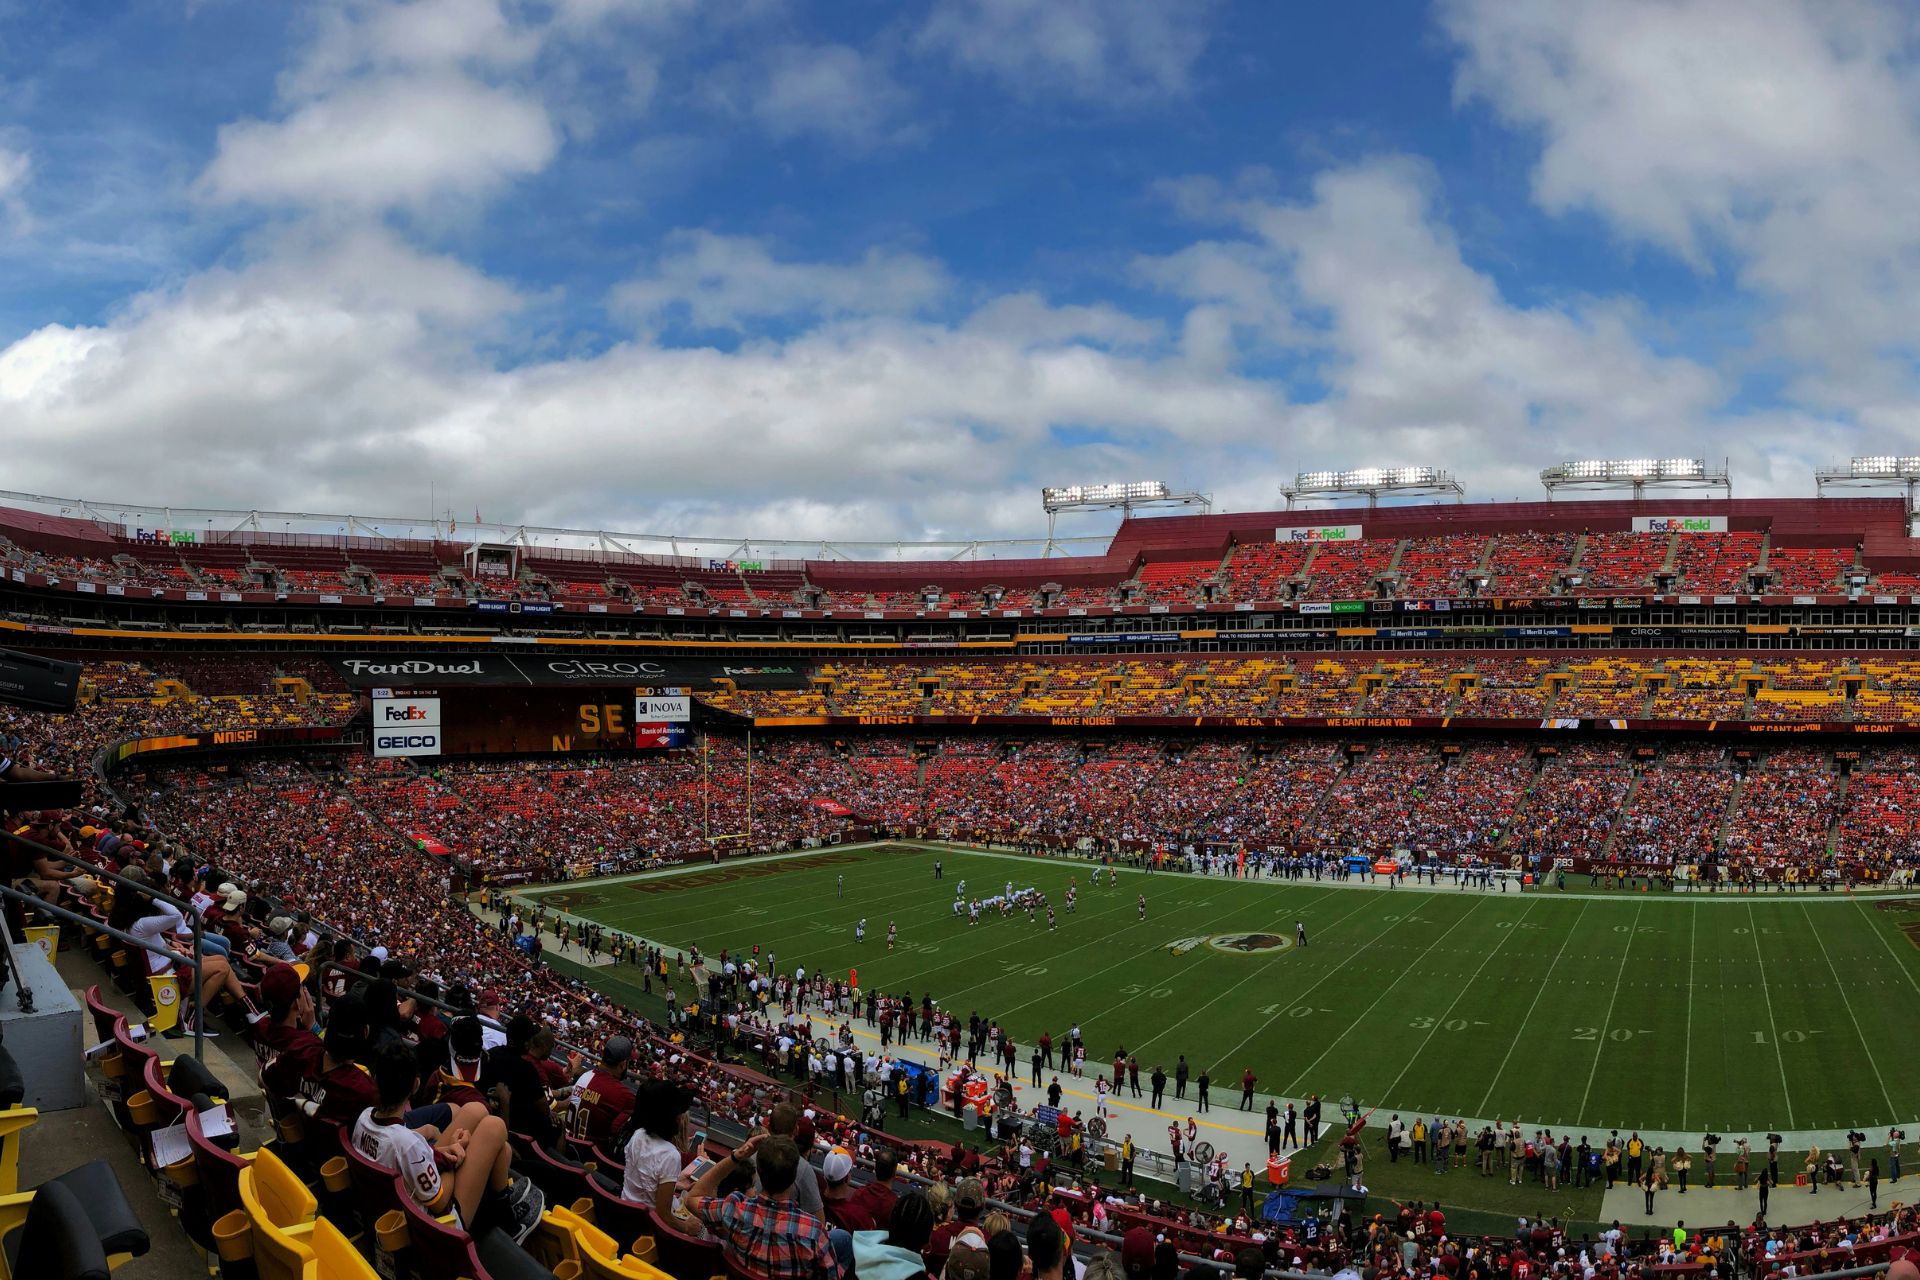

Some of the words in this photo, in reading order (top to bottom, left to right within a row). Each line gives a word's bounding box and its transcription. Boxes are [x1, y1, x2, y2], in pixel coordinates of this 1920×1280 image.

[1649, 518, 1711, 530] FedExField
[1291, 528, 1346, 540] FedExField
[1404, 601, 1431, 610] FedEx
[342, 659, 485, 675] FanDuel
[385, 705, 426, 720] FedEx
[651, 702, 683, 713] INOVA
[1052, 717, 1080, 726] MAKE
[1082, 717, 1115, 726] NOISE!
[1235, 718, 1249, 726] WE
[1326, 718, 1341, 727] WE
[1342, 718, 1366, 727] CANT
[1368, 718, 1392, 727] HEAR
[1393, 718, 1412, 727] YOU
[641, 727, 656, 735] Bank
[656, 727, 663, 735] of
[662, 727, 685, 735] America
[1870, 725, 1894, 733] CANT
[377, 735, 436, 749] GEICO
[1267, 845, 1285, 853] 1972
[1256, 1003, 1313, 1018] 40
[1409, 1016, 1468, 1032] 30
[1571, 1026, 1633, 1042] 20
[1751, 1030, 1806, 1044] 10
[360, 1130, 380, 1161] MOSS
[416, 1163, 438, 1192] 89
[1306, 1227, 1317, 1239] 12
[1415, 1223, 1426, 1236] 60
[1551, 1236, 1563, 1247] 24
[1518, 1269, 1528, 1279] 77
